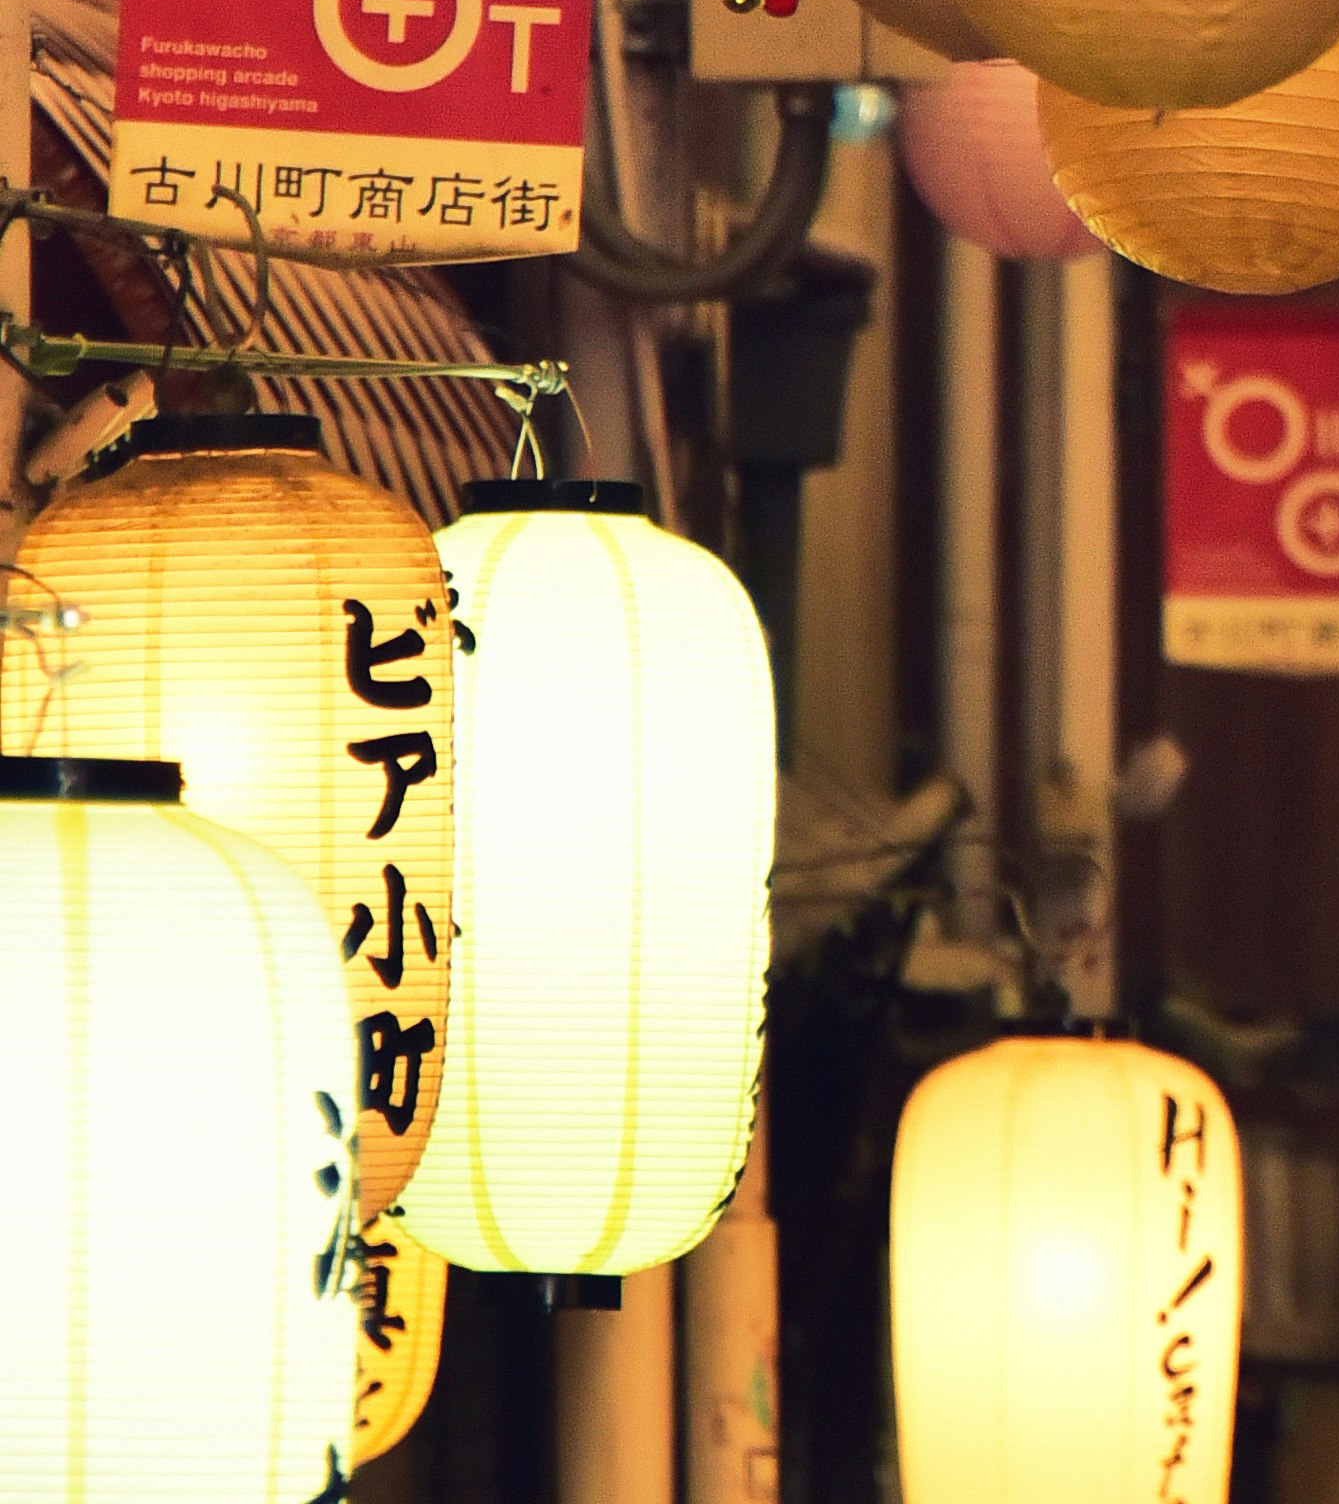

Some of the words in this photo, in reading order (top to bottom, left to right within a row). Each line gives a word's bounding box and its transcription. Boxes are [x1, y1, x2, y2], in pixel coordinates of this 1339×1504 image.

[141, 35, 268, 60] Furukawacho
[139, 62, 226, 86] shopping
[233, 68, 299, 87] arcade
[138, 87, 193, 107] Kyoto
[200, 91, 318, 115] higashiyama
[129, 155, 560, 232] 古川町商店街
[343, 596, 438, 1137] ビア小町
